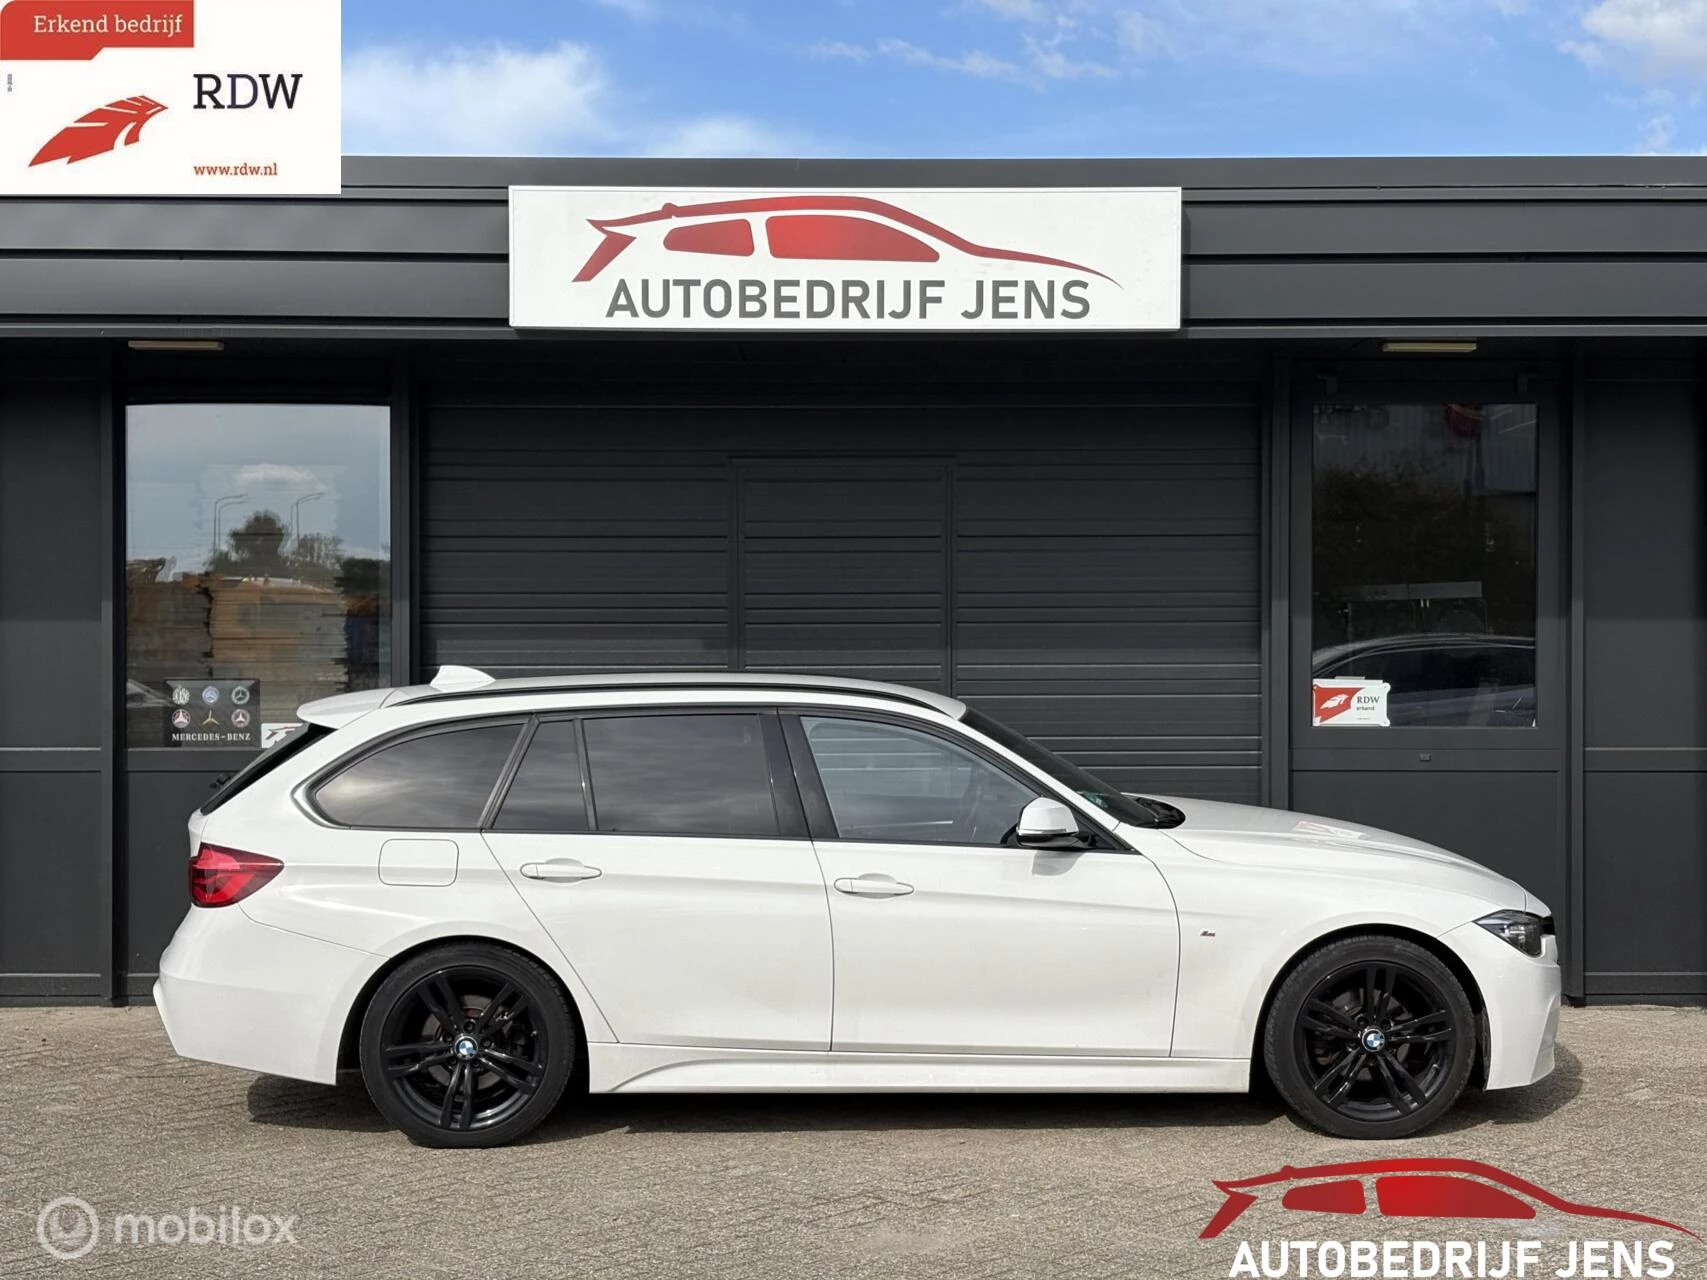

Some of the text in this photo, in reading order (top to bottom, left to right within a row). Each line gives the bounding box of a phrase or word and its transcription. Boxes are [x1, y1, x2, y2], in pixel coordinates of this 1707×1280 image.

[606, 279, 1091, 319] AUTOBEDRIJF JENS
[1356, 696, 1380, 704] RDW
[171, 733, 251, 741] MERCEDES-BENZ
